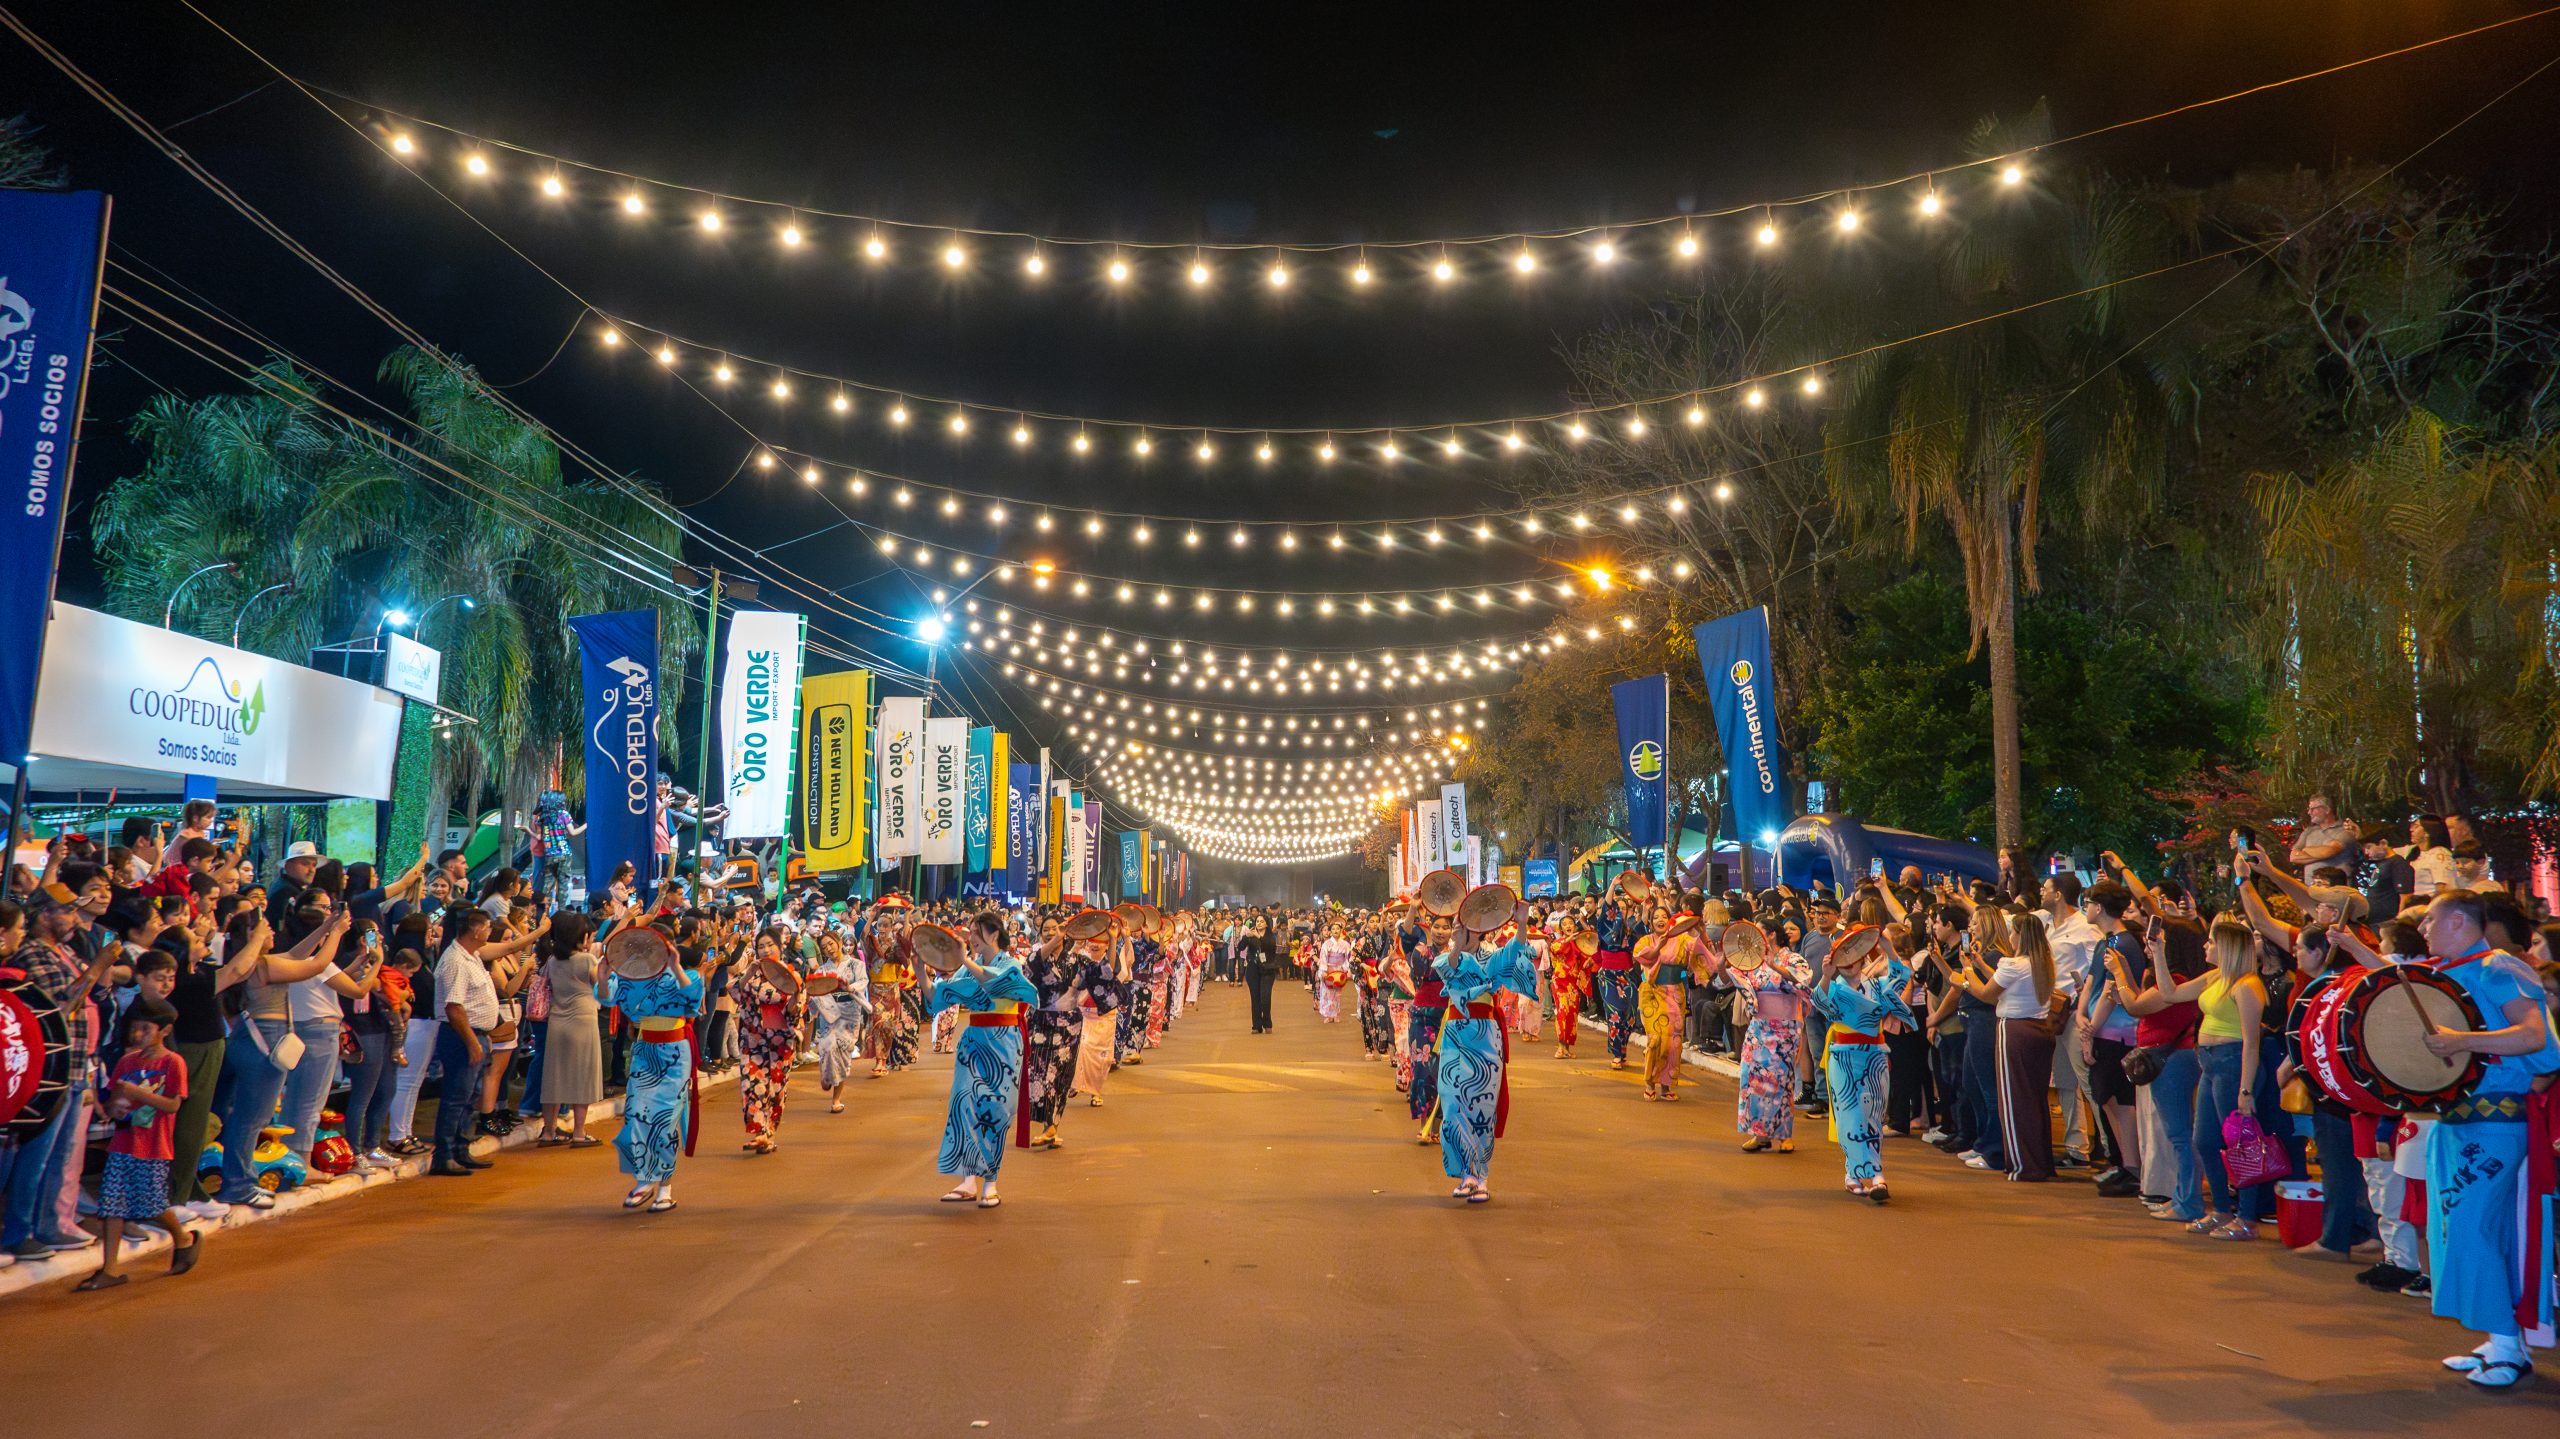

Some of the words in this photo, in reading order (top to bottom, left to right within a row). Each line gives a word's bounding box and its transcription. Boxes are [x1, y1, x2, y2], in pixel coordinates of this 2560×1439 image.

[12, 333, 36, 384] Ltda.
[39, 353, 69, 434] SOCIOS
[26, 439, 55, 517] SOMOS
[746, 649, 770, 725] VERDE
[772, 650, 780, 684] EXPORT
[129, 687, 242, 734] COOPEDUC
[158, 737, 198, 761] Somos
[200, 744, 237, 767] Socios
[626, 685, 649, 815] COOPEDUC
[742, 732, 768, 783] ORO
[830, 737, 841, 769] NEW
[889, 743, 902, 778] ORO
[1738, 684, 1775, 794] continental
[809, 734, 820, 826] CONSTRUCTION
[937, 744, 952, 793] VERDE
[970, 762, 981, 802] AESA
[830, 775, 841, 838] HOLLAND
[892, 785, 904, 838] VERDE
[938, 797, 953, 830] ORO
[1010, 800, 1021, 857] COOPEDUC
[1451, 795, 1460, 839] Caltech
